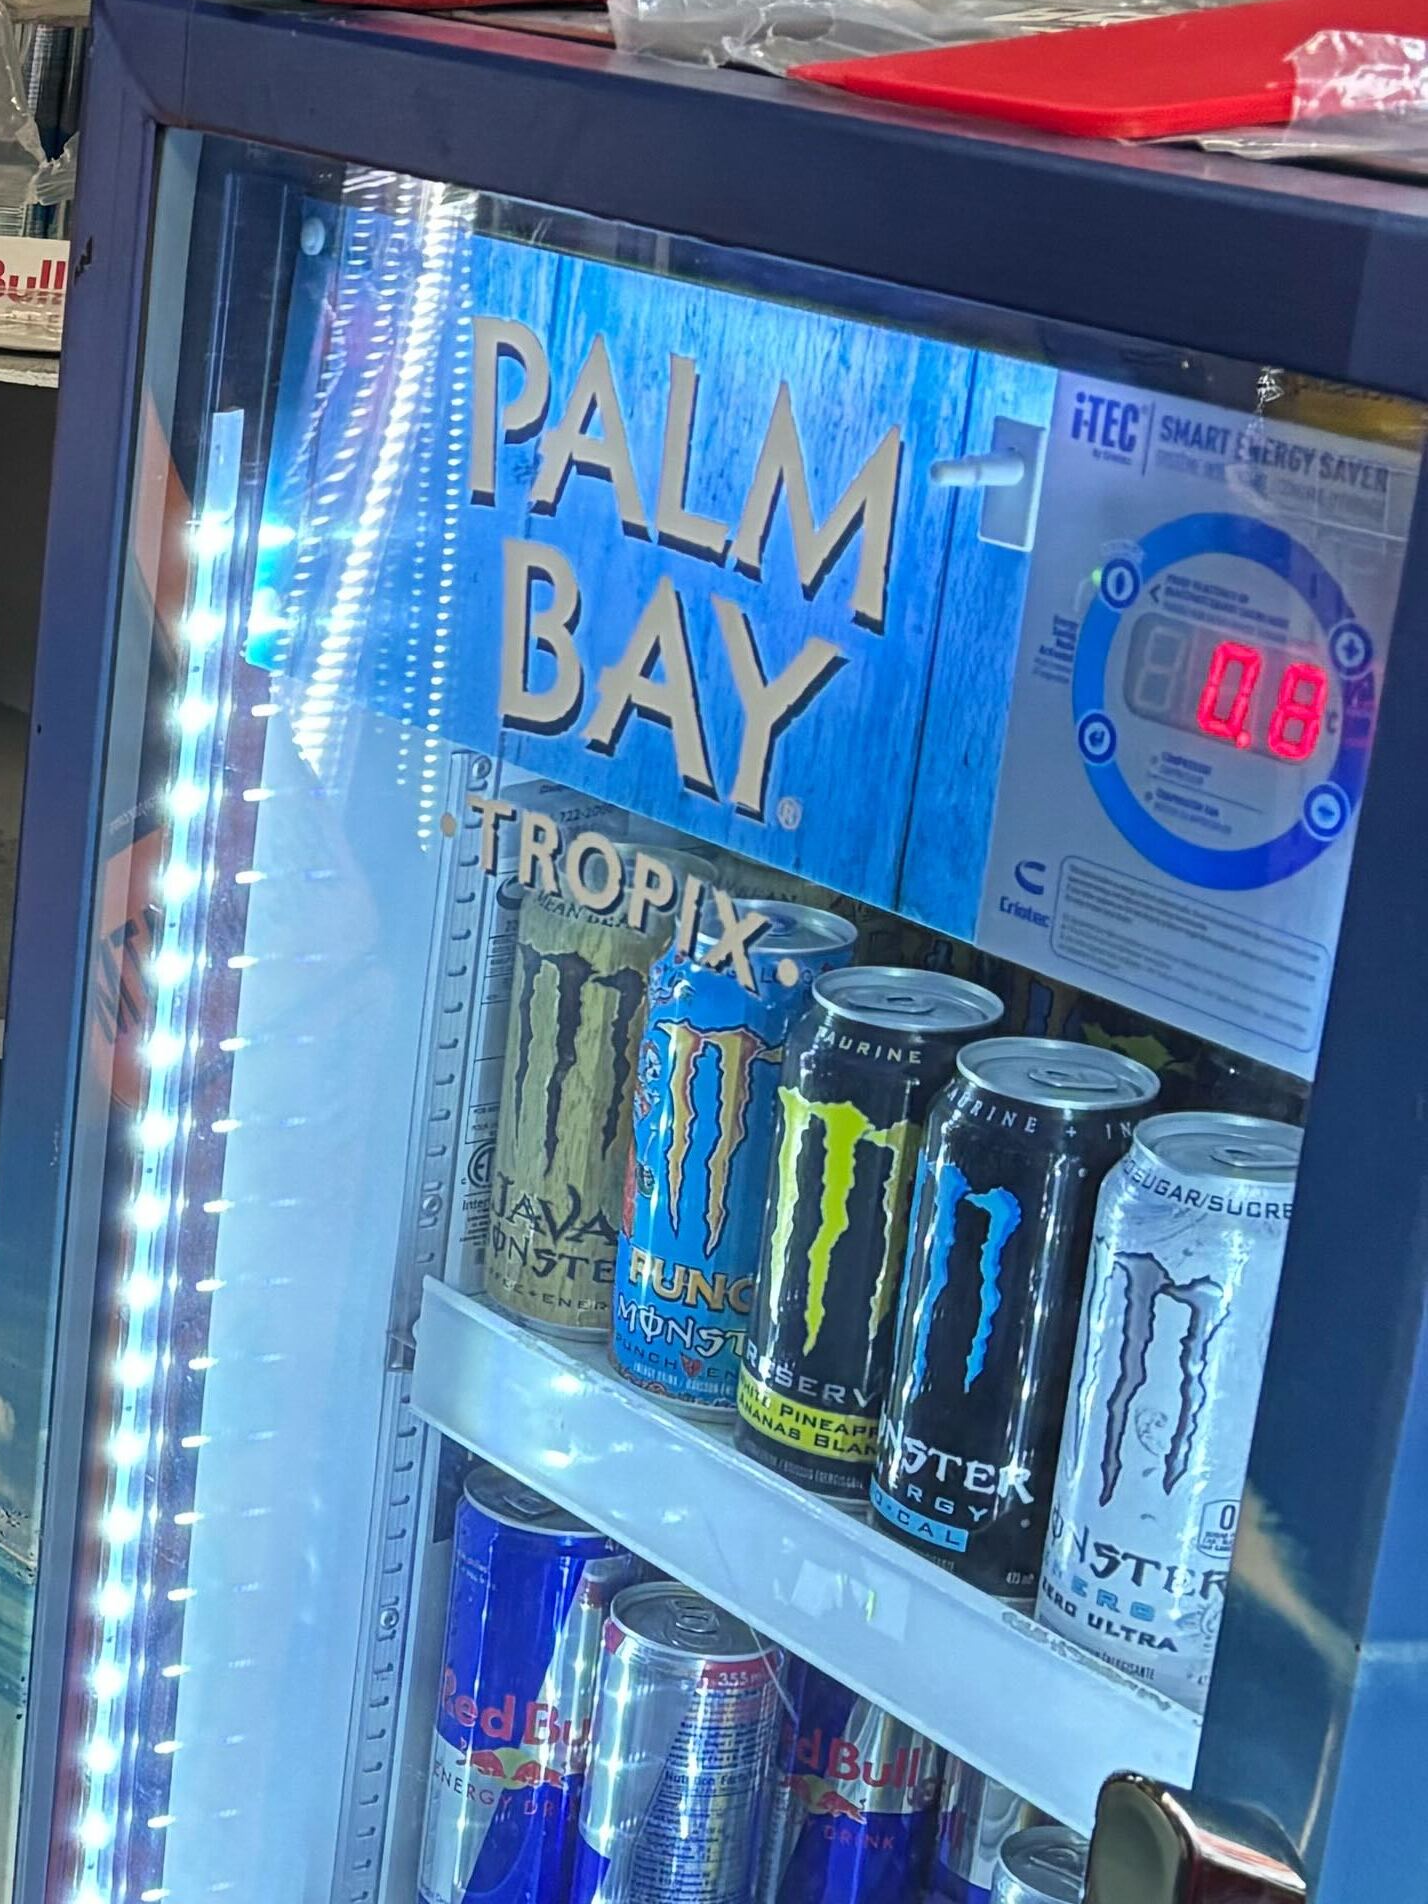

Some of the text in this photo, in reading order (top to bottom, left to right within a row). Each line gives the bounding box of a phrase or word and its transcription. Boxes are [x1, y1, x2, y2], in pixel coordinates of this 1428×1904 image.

[469, 314, 904, 636] PALM
[1160, 415, 1231, 457] SMART
[503, 538, 846, 824] BAY
[466, 794, 772, 997] TROPIX
[491, 1170, 620, 1246] JAVA
[1088, 1614, 1178, 1654] ULTRA
